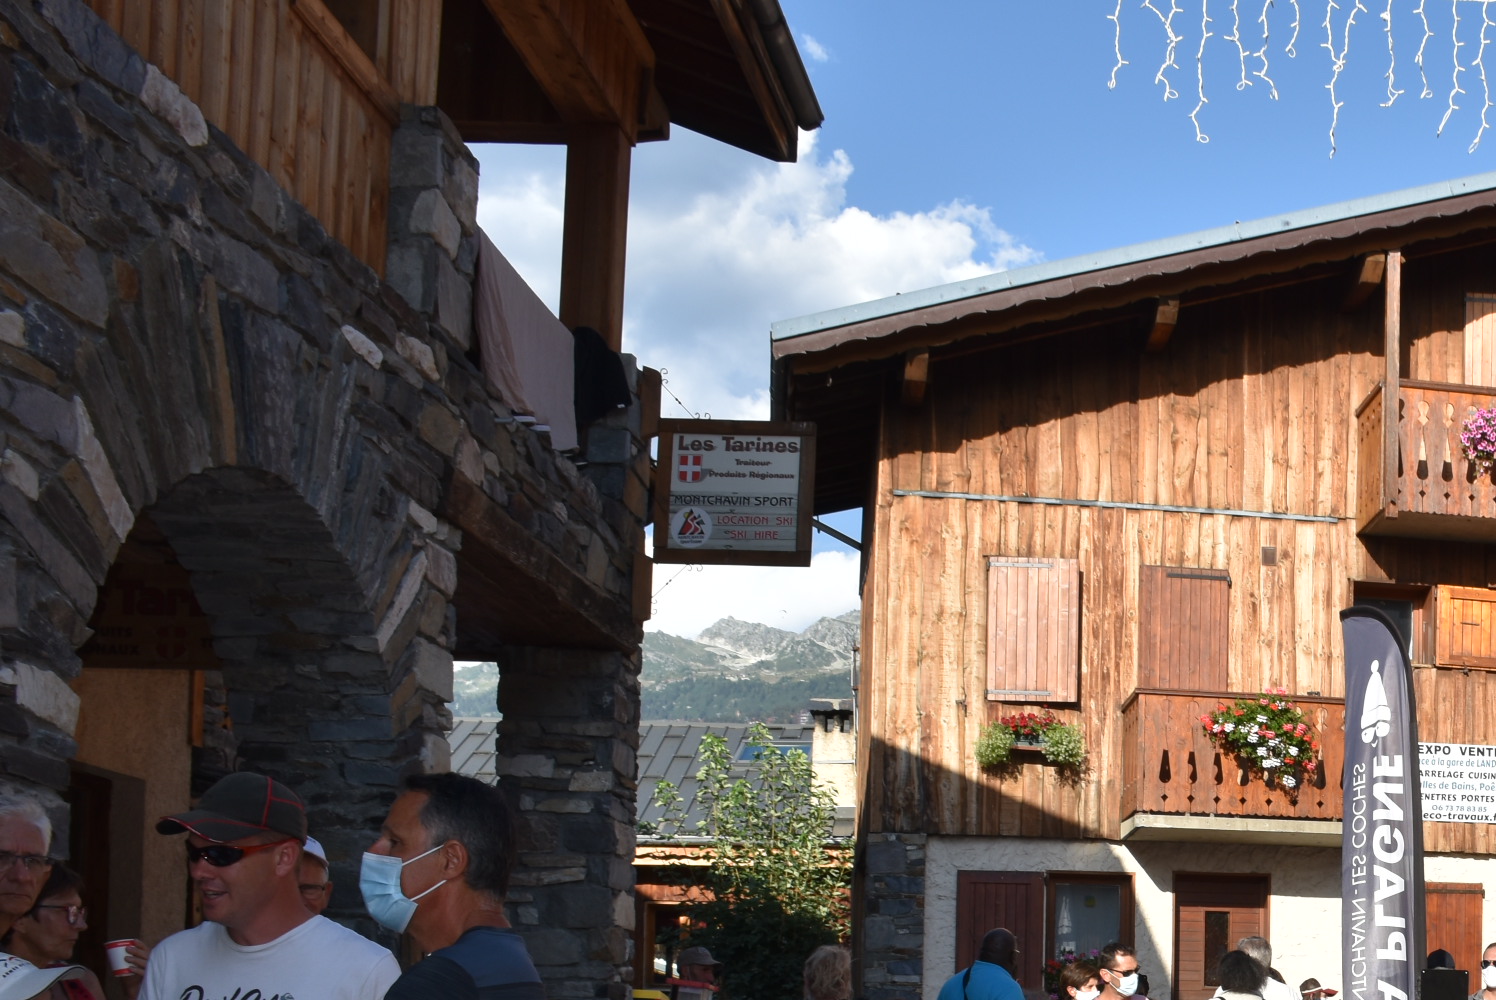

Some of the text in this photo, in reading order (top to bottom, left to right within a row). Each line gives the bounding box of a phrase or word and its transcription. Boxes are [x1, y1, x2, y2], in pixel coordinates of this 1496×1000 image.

[678, 435, 800, 453] Les Tarines
[708, 470, 795, 480] Produits Régionaux
[674, 495, 794, 507] MONTCHAVIN SPORT
[717, 515, 793, 525] LOCATION SKI
[730, 530, 779, 539] SKI HIRE
[1418, 744, 1451, 755] EXPO
[1437, 758, 1445, 766] la
[1446, 758, 1464, 769] gare
[1465, 758, 1475, 767] de
[1419, 769, 1464, 779] ARRELAGE
[1421, 780, 1437, 790] lles
[1438, 781, 1449, 790] de
[1420, 792, 1457, 802] ENETRES
